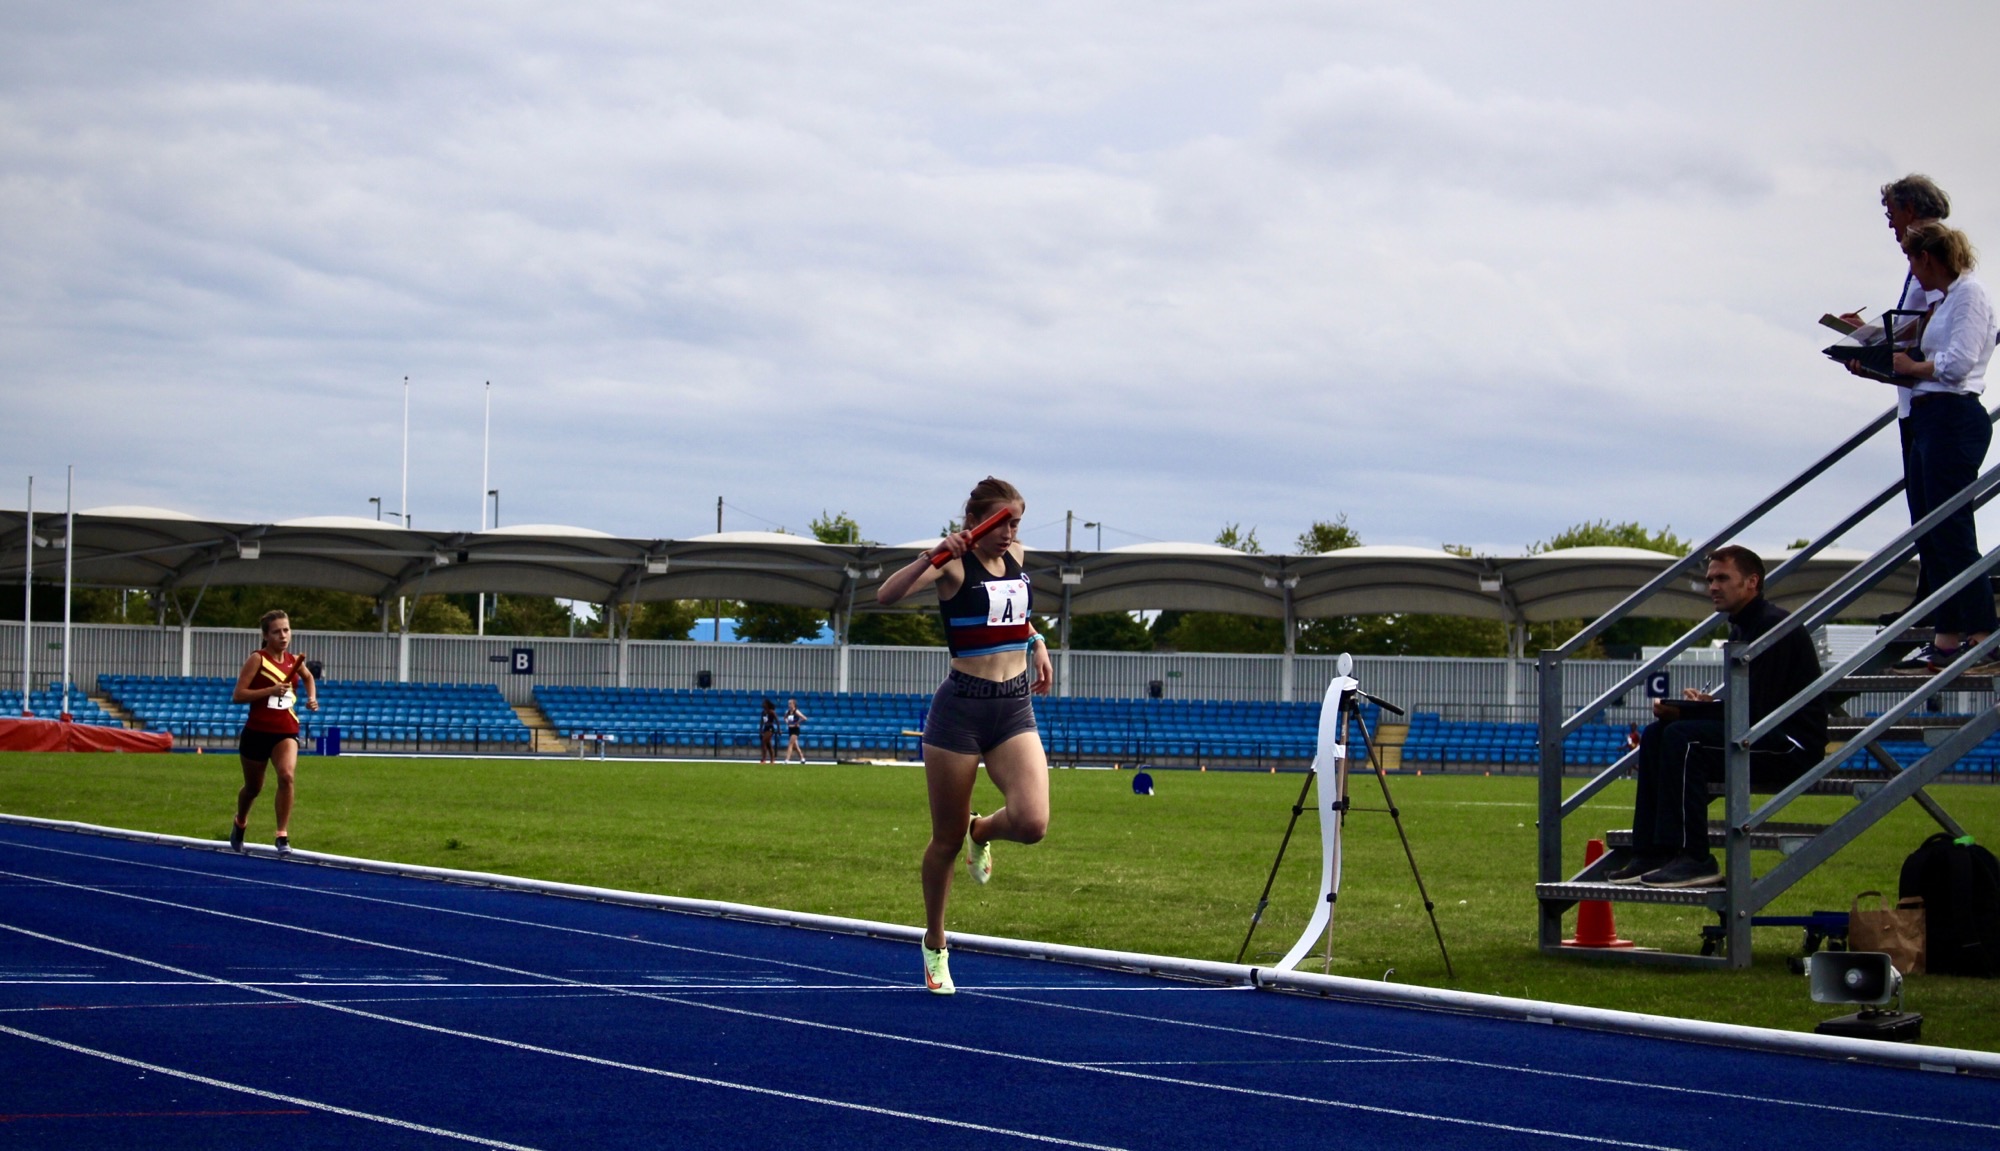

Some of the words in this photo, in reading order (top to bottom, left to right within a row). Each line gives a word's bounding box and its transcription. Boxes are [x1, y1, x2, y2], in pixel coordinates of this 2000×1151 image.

[1001, 598, 1013, 623] A
[516, 653, 529, 670] B
[956, 681, 992, 697] PRO
[996, 673, 1026, 697] NIKE
[1652, 676, 1665, 693] C
